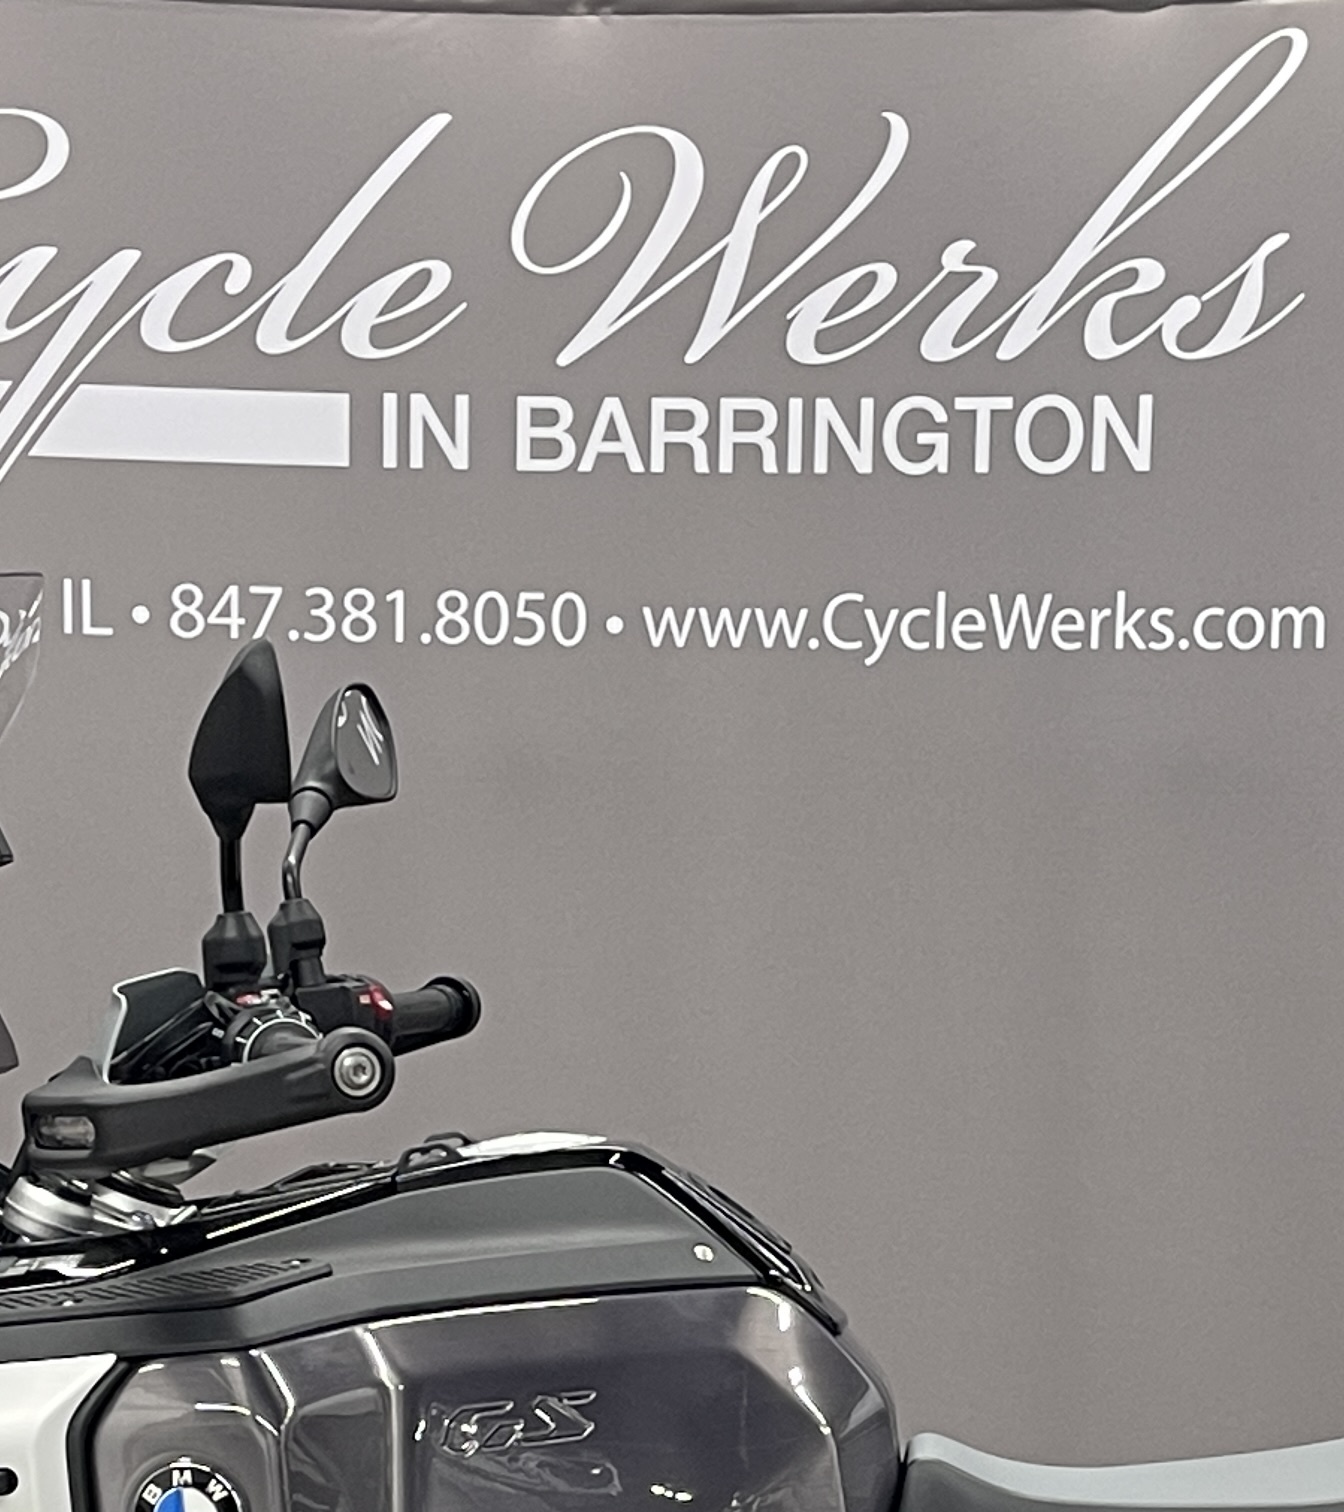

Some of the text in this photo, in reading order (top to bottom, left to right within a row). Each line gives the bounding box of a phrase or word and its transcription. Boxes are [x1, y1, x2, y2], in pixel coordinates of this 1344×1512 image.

[511, 27, 1308, 367] Werks
[383, 392, 1153, 475] IN BARRINGTON
[63, 578, 114, 636] IL
[169, 583, 587, 647] 847.381.8050
[642, 590, 1325, 666] www.CycleWerks.com
[141, 1468, 230, 1506] BMW
